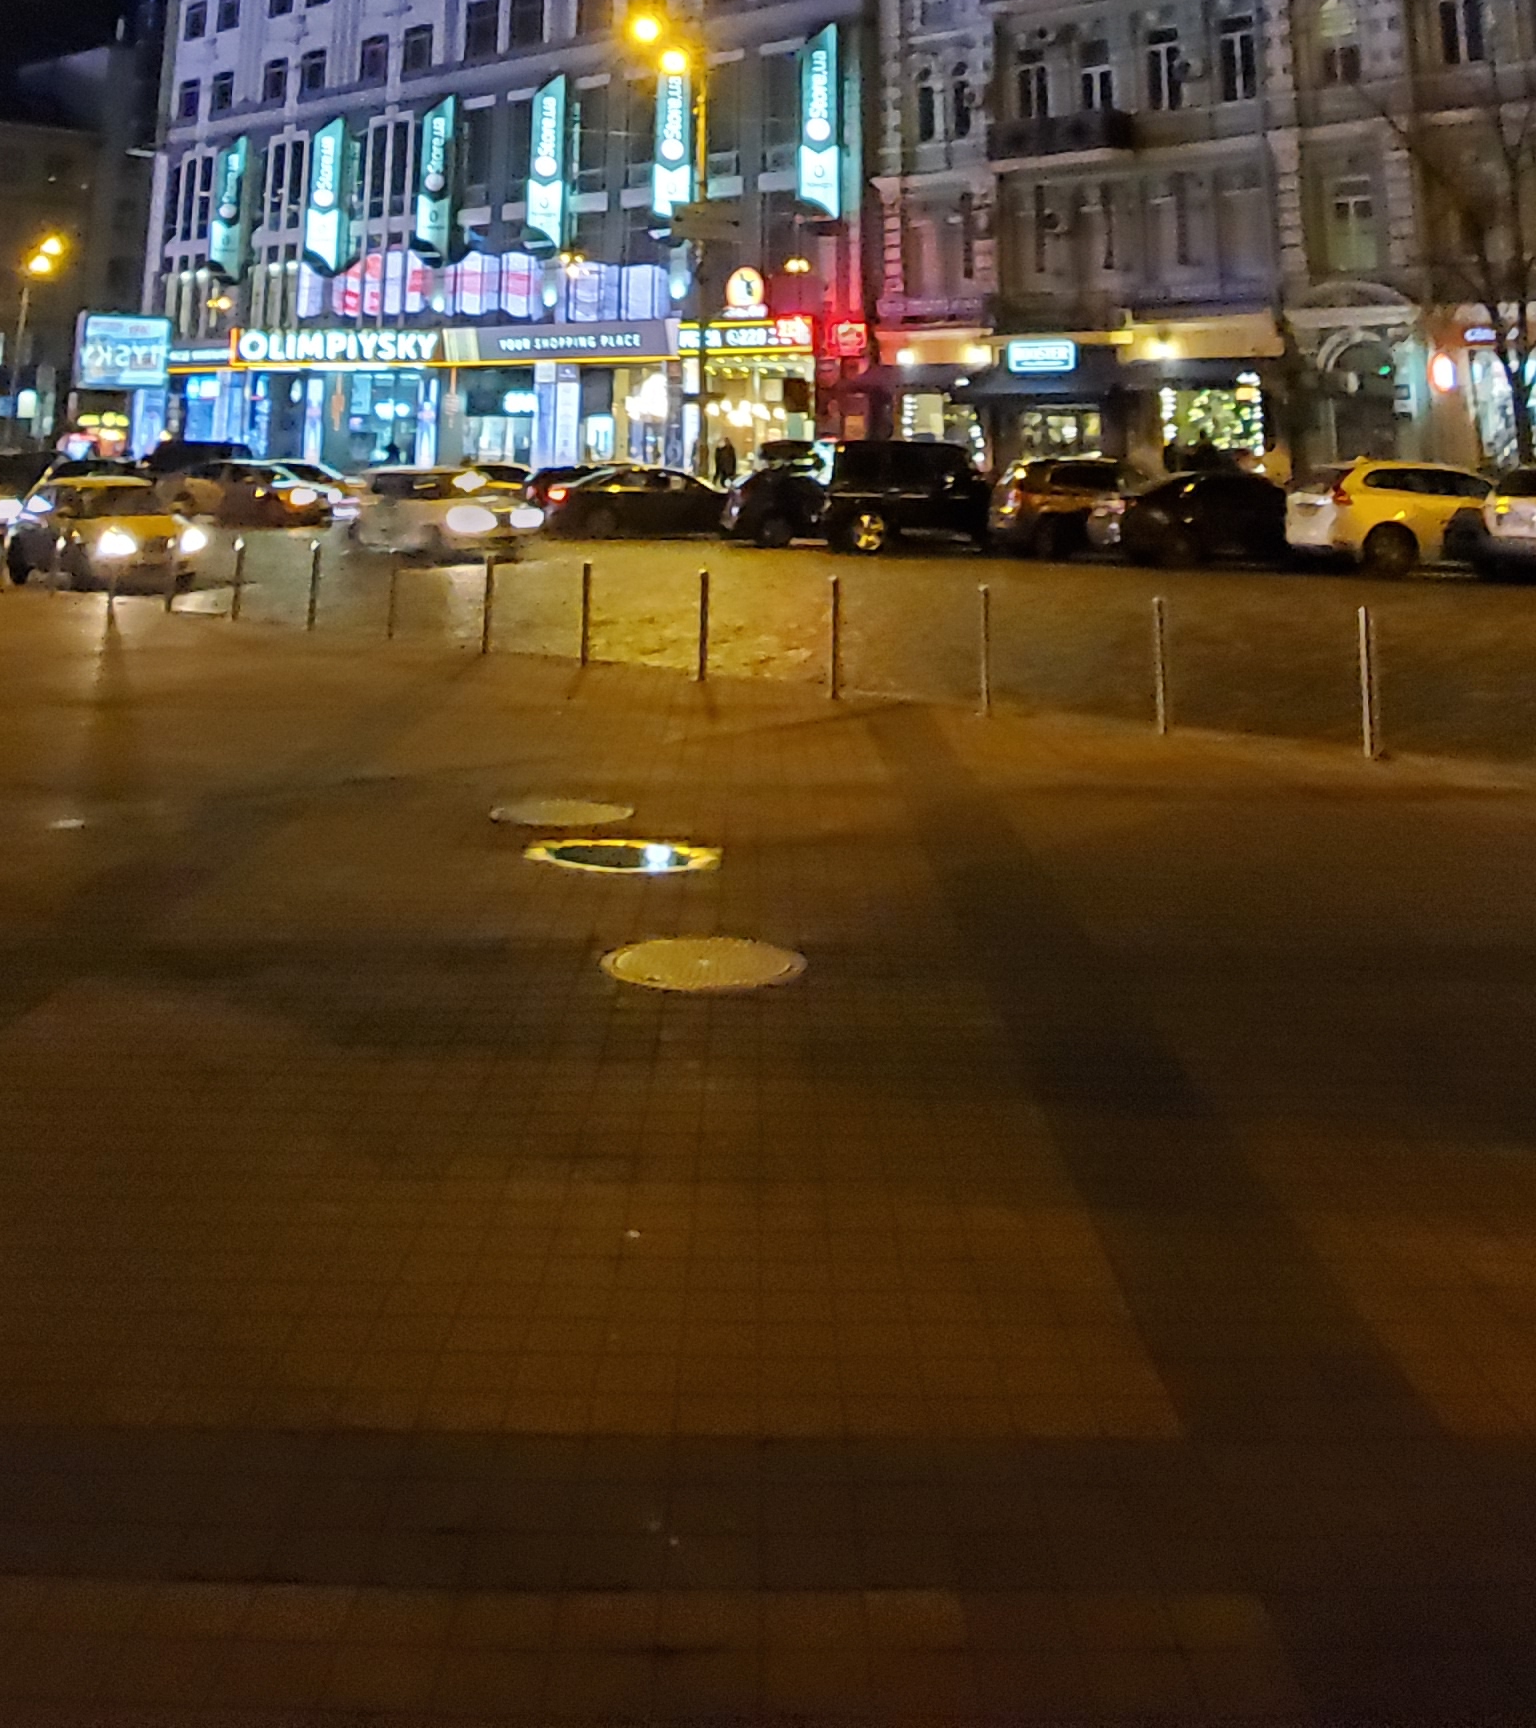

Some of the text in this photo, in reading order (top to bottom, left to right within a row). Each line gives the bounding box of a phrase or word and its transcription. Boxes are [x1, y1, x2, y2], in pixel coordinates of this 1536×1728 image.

[238, 329, 439, 362] OLIMPIYSKY
[498, 332, 642, 352] YOUR SHOPPING PLACE
